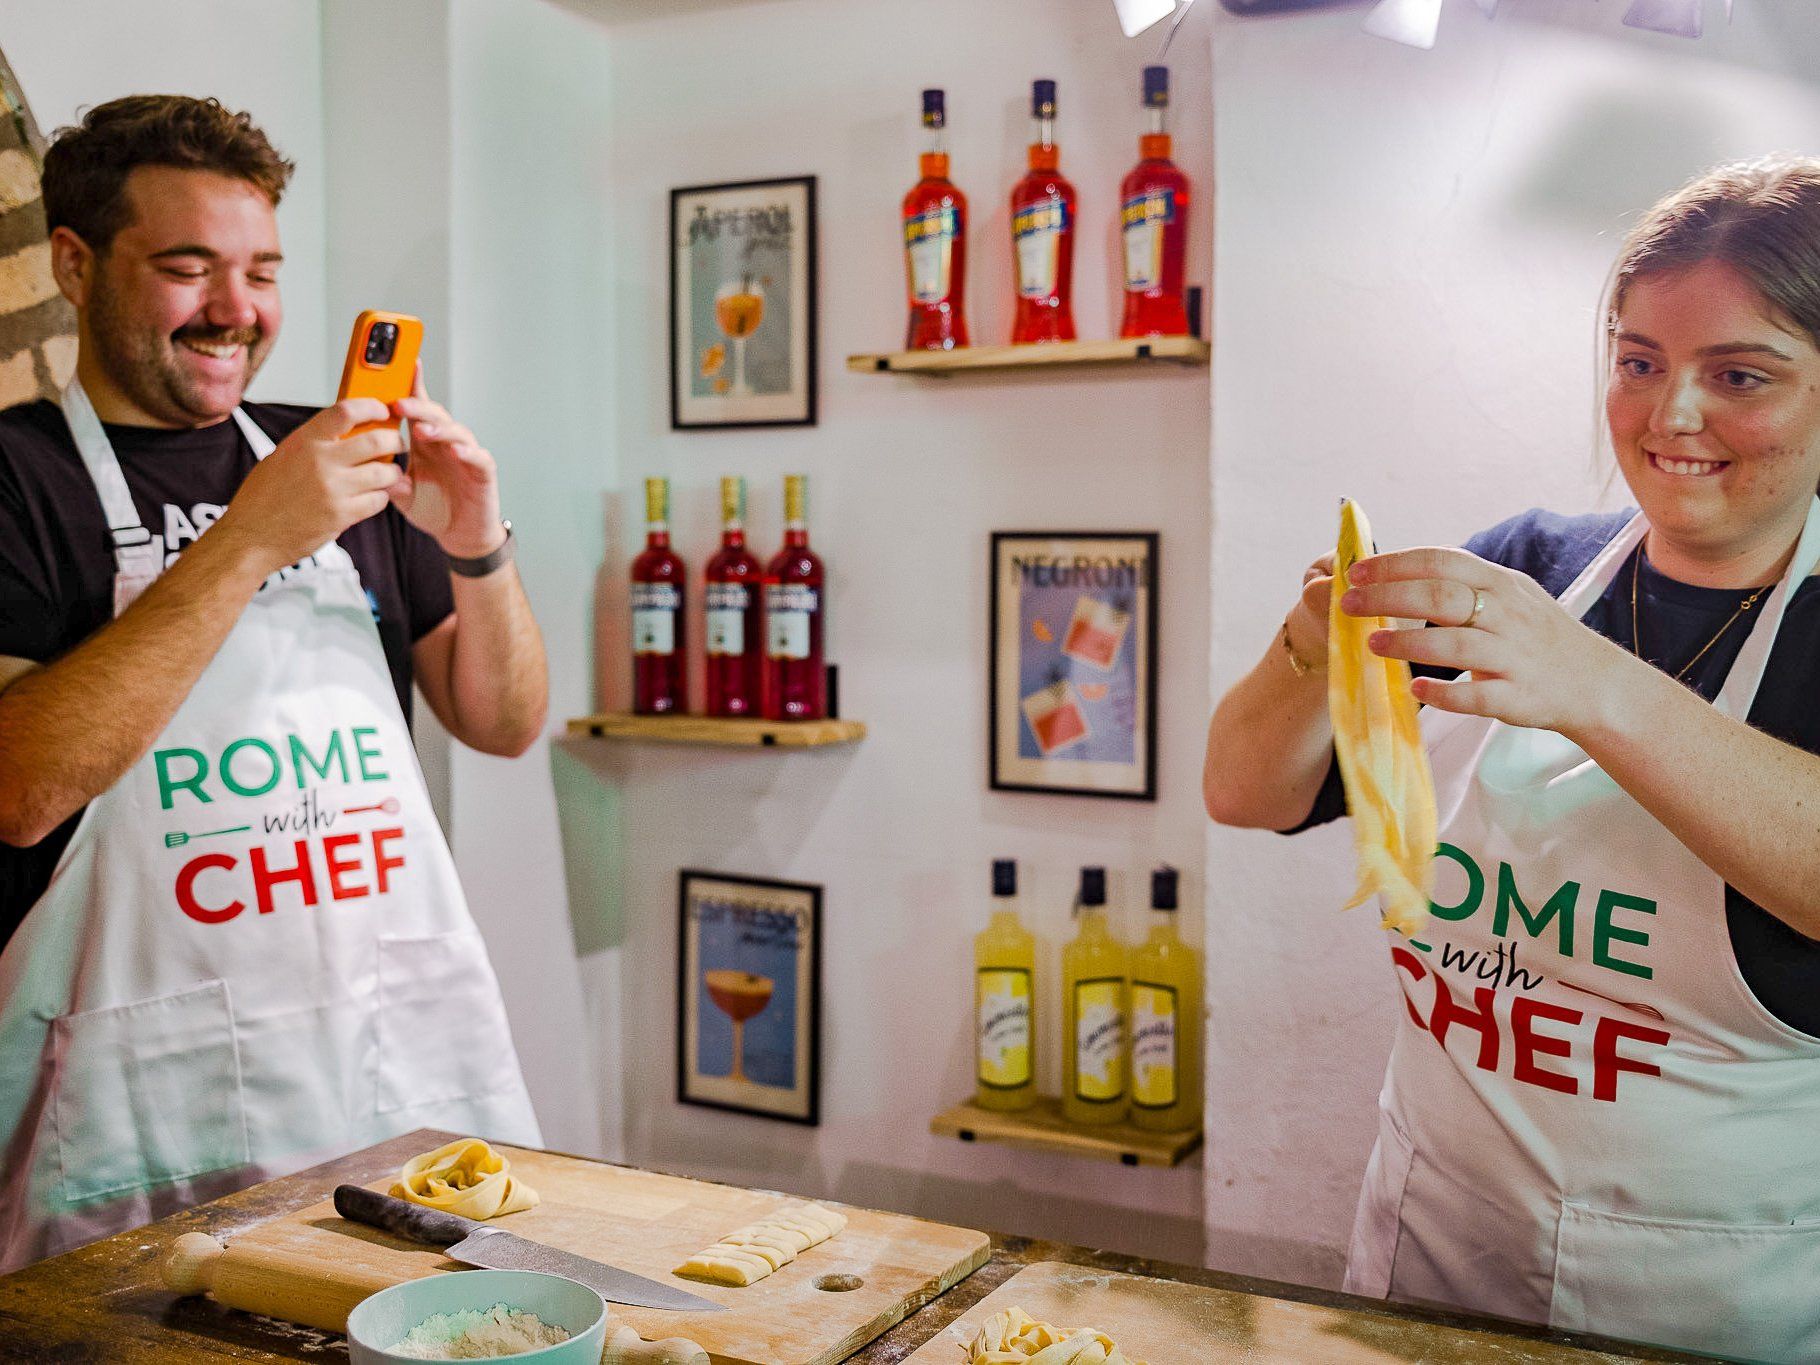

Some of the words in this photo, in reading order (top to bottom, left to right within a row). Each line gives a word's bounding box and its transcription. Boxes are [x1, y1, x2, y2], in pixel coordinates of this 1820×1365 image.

[154, 728, 390, 810] ROME
[264, 789, 337, 835] with
[175, 828, 406, 925] CHEF
[1428, 842, 1658, 980] OME
[1441, 941, 1545, 991] with
